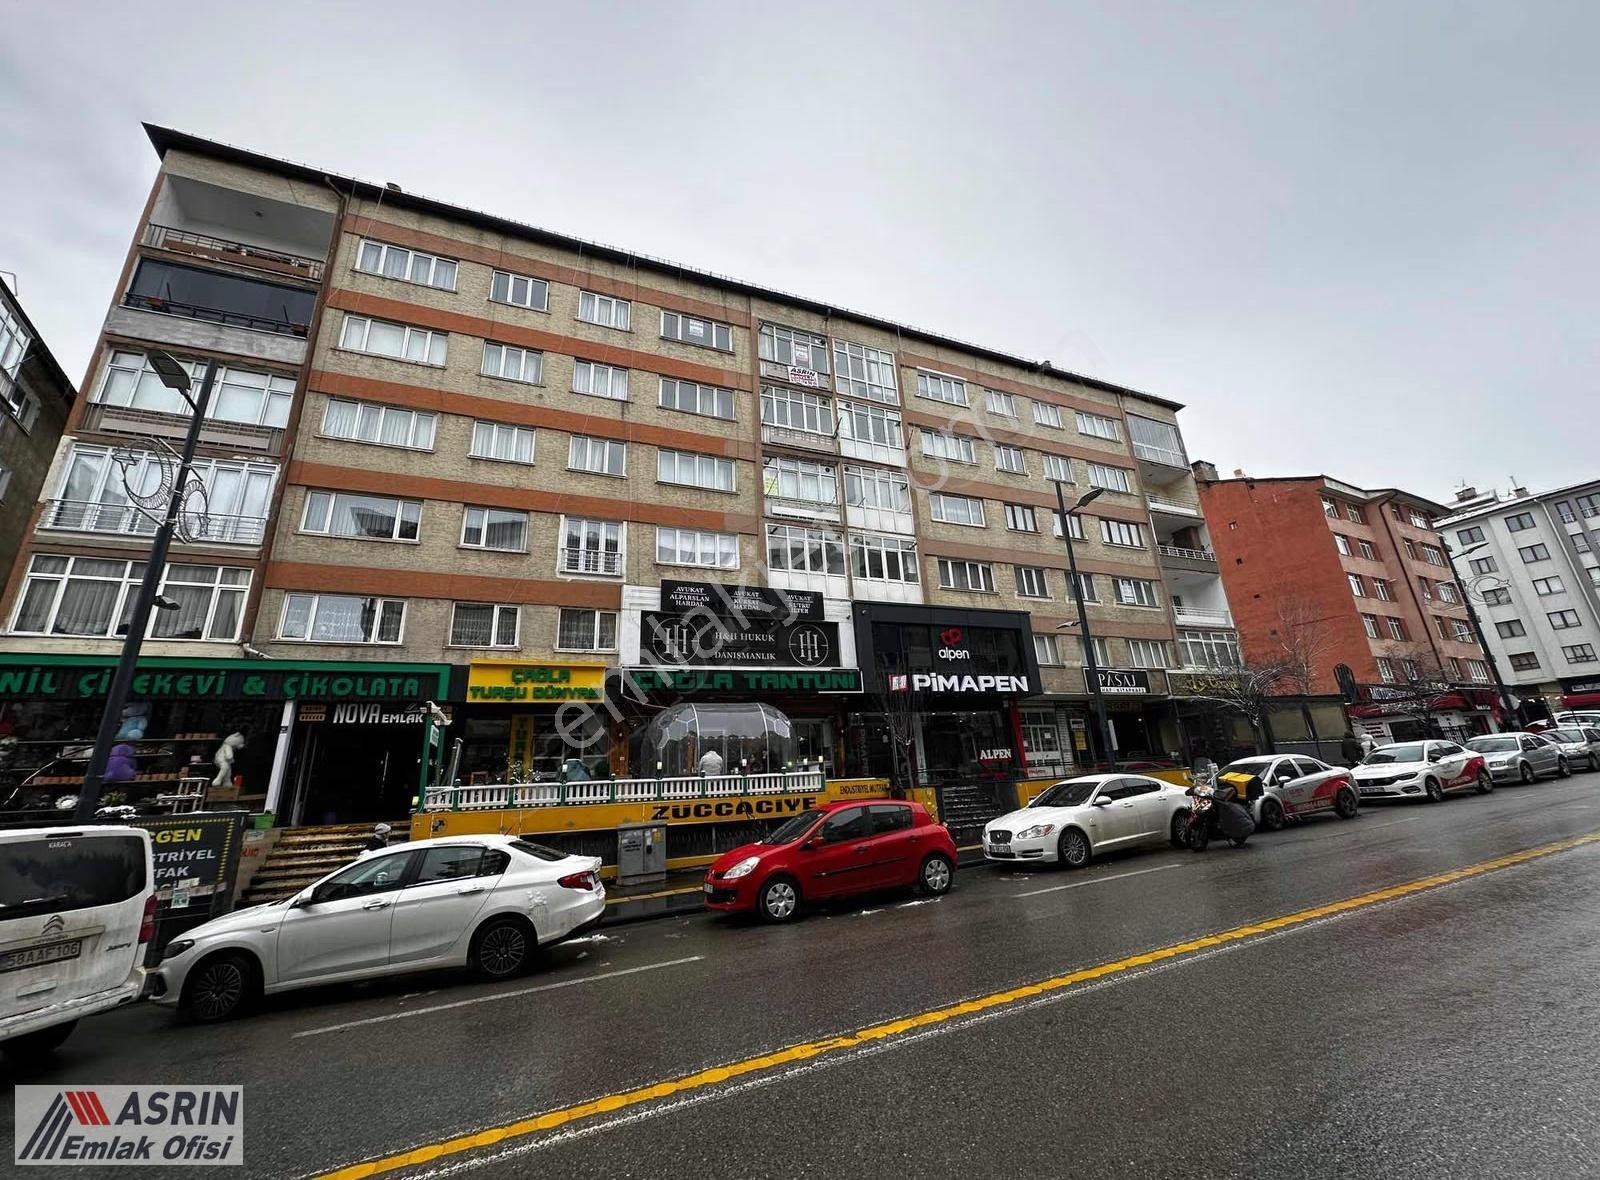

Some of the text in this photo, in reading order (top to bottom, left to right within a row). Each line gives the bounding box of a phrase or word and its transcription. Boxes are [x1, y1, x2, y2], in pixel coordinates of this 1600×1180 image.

[676, 586, 704, 594] AVUKAT
[733, 590, 760, 598] AVUKAT
[669, 594, 710, 602] ALPARSLAN
[786, 594, 812, 602] AVUKAT
[675, 600, 705, 608] HARDAL
[715, 631, 776, 643] H&H HUKUK
[714, 651, 777, 662] DANIŞMANLIK
[938, 646, 970, 661] alpen
[78, 668, 227, 698] ÇİEKEVİ
[242, 676, 266, 696] &
[282, 673, 420, 699] ÇİKOLATA
[469, 686, 527, 700] TURŞU
[333, 703, 381, 724] NOVA
[381, 712, 424, 724] EMLAK
[980, 748, 1012, 760] ALPEN
